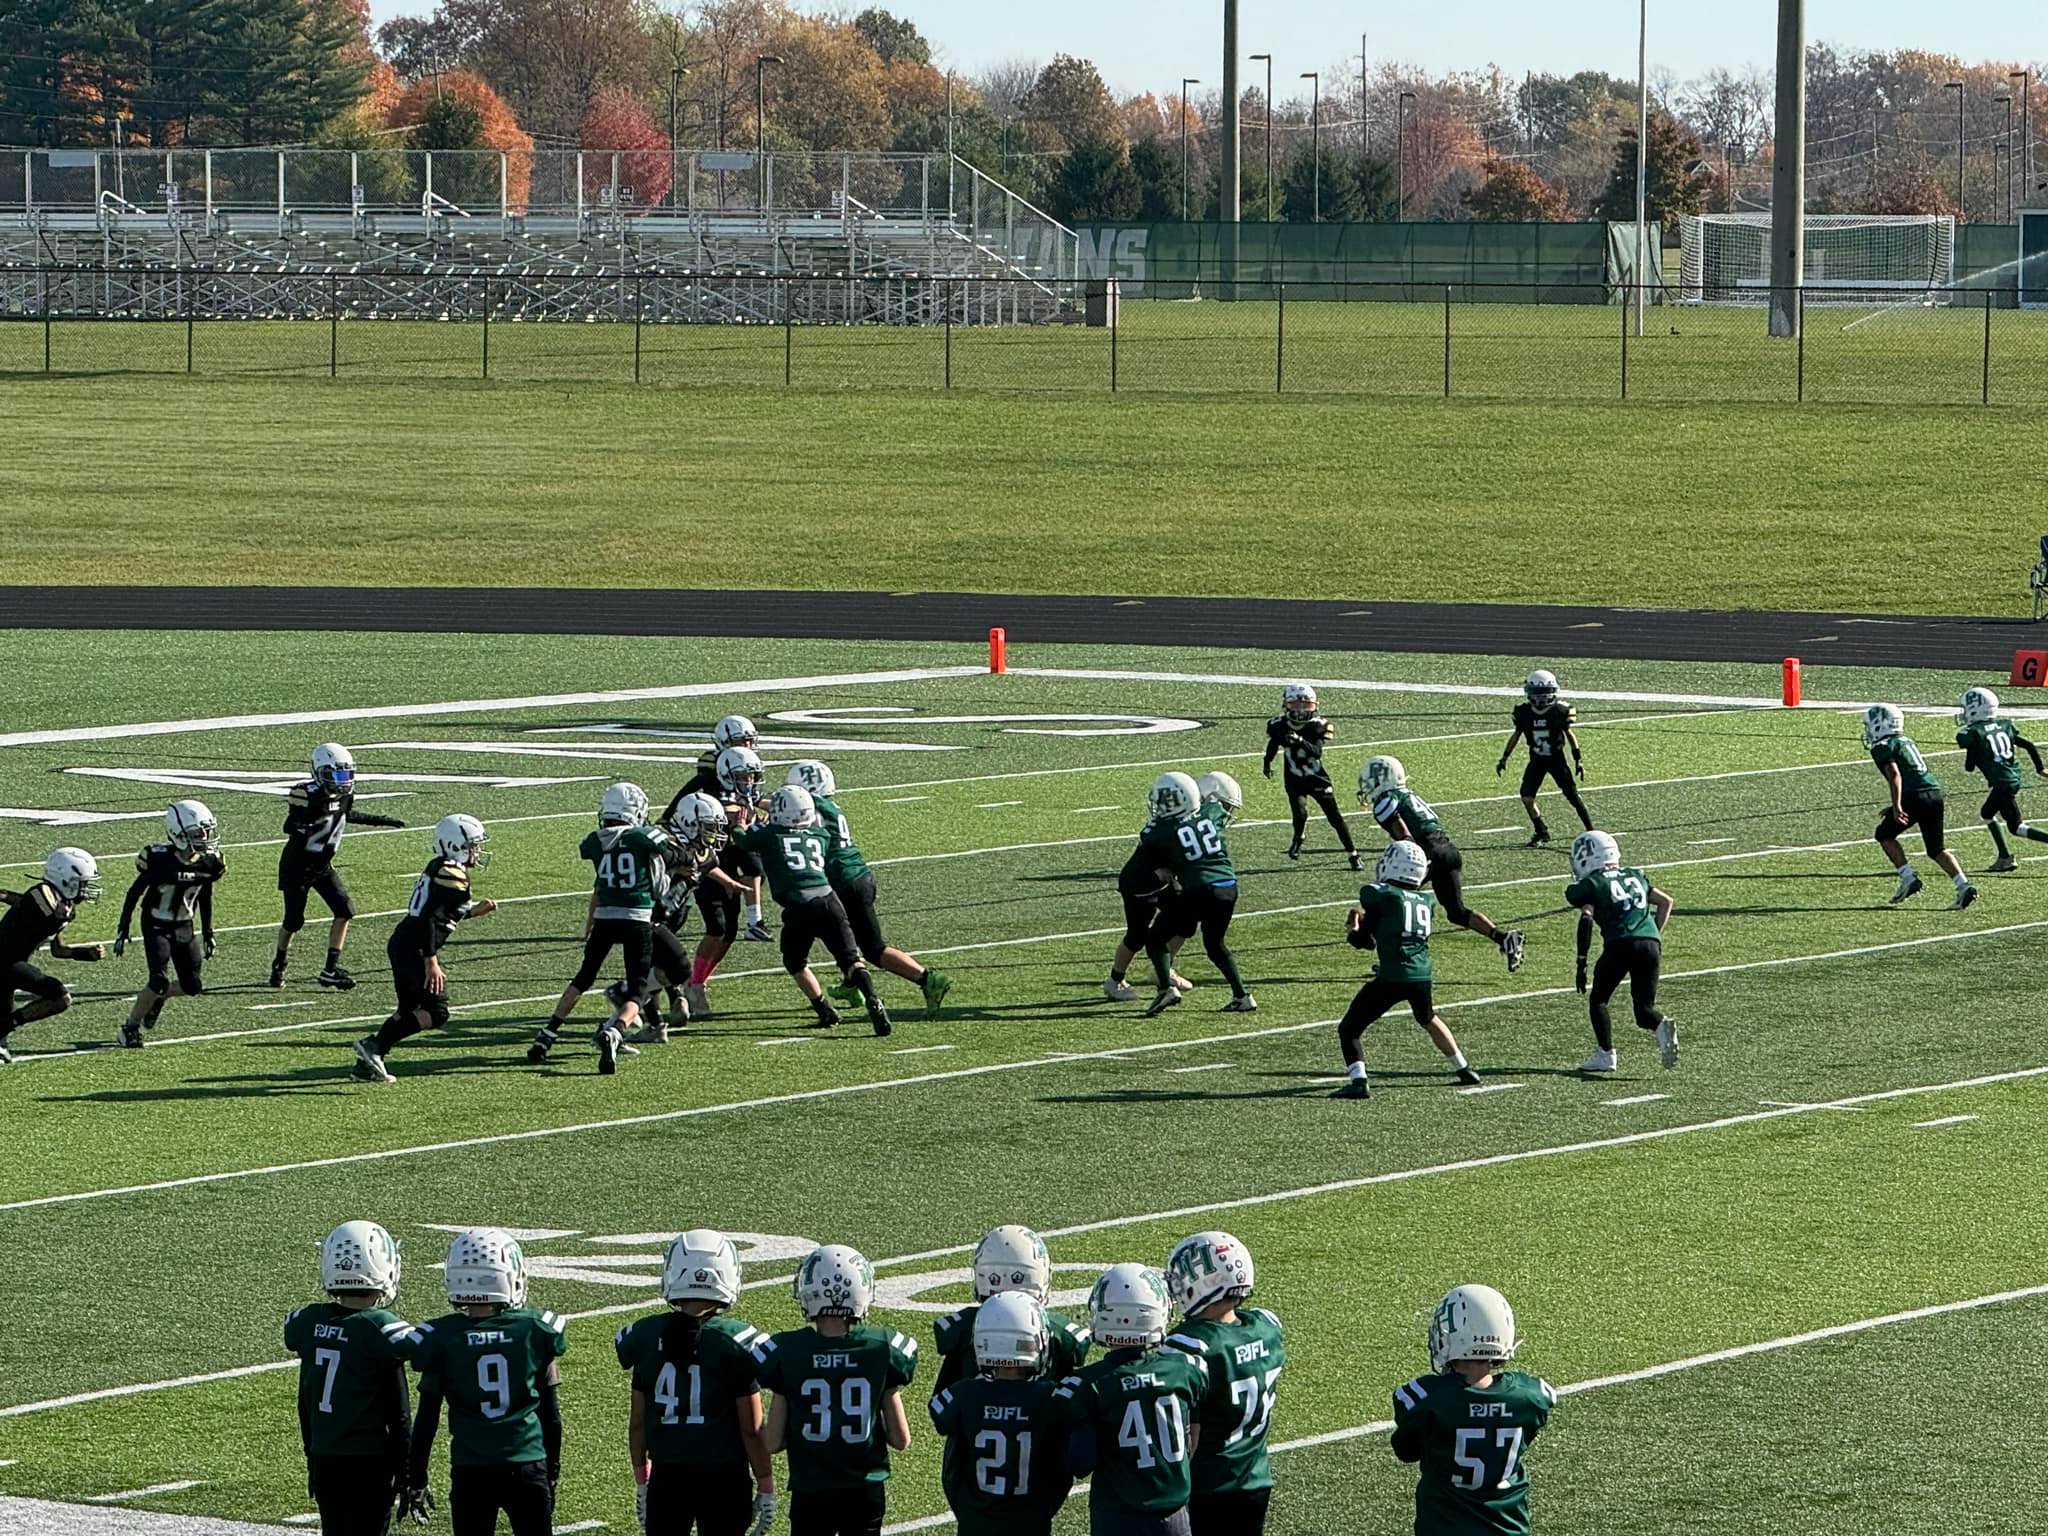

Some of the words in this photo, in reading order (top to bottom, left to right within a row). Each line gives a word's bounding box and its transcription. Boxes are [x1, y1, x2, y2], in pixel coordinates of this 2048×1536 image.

[2022, 657, 2038, 681] G
[1533, 731, 1551, 756] 5
[1986, 732, 2012, 760] 10
[783, 836, 825, 873] 53
[1177, 818, 1222, 862] 92
[598, 853, 636, 889] 49
[1609, 876, 1648, 911] 43
[1400, 901, 1431, 938] 19
[314, 1323, 348, 1342] PJFL
[467, 1330, 513, 1346] PJFL
[1105, 1334, 1148, 1345] Riddell
[812, 1354, 858, 1369] PJFL
[1233, 1339, 1270, 1365] PJFL
[315, 1347, 341, 1413] 7
[476, 1353, 510, 1419] 9
[654, 1361, 705, 1425] 41
[1120, 1373, 1167, 1392] PJFL
[800, 1377, 872, 1443] 39
[983, 1405, 1030, 1421] PJFL
[1468, 1402, 1513, 1418] PJFL
[1117, 1393, 1186, 1470] 40
[974, 1429, 1032, 1496] 21
[1451, 1426, 1524, 1491] 57
